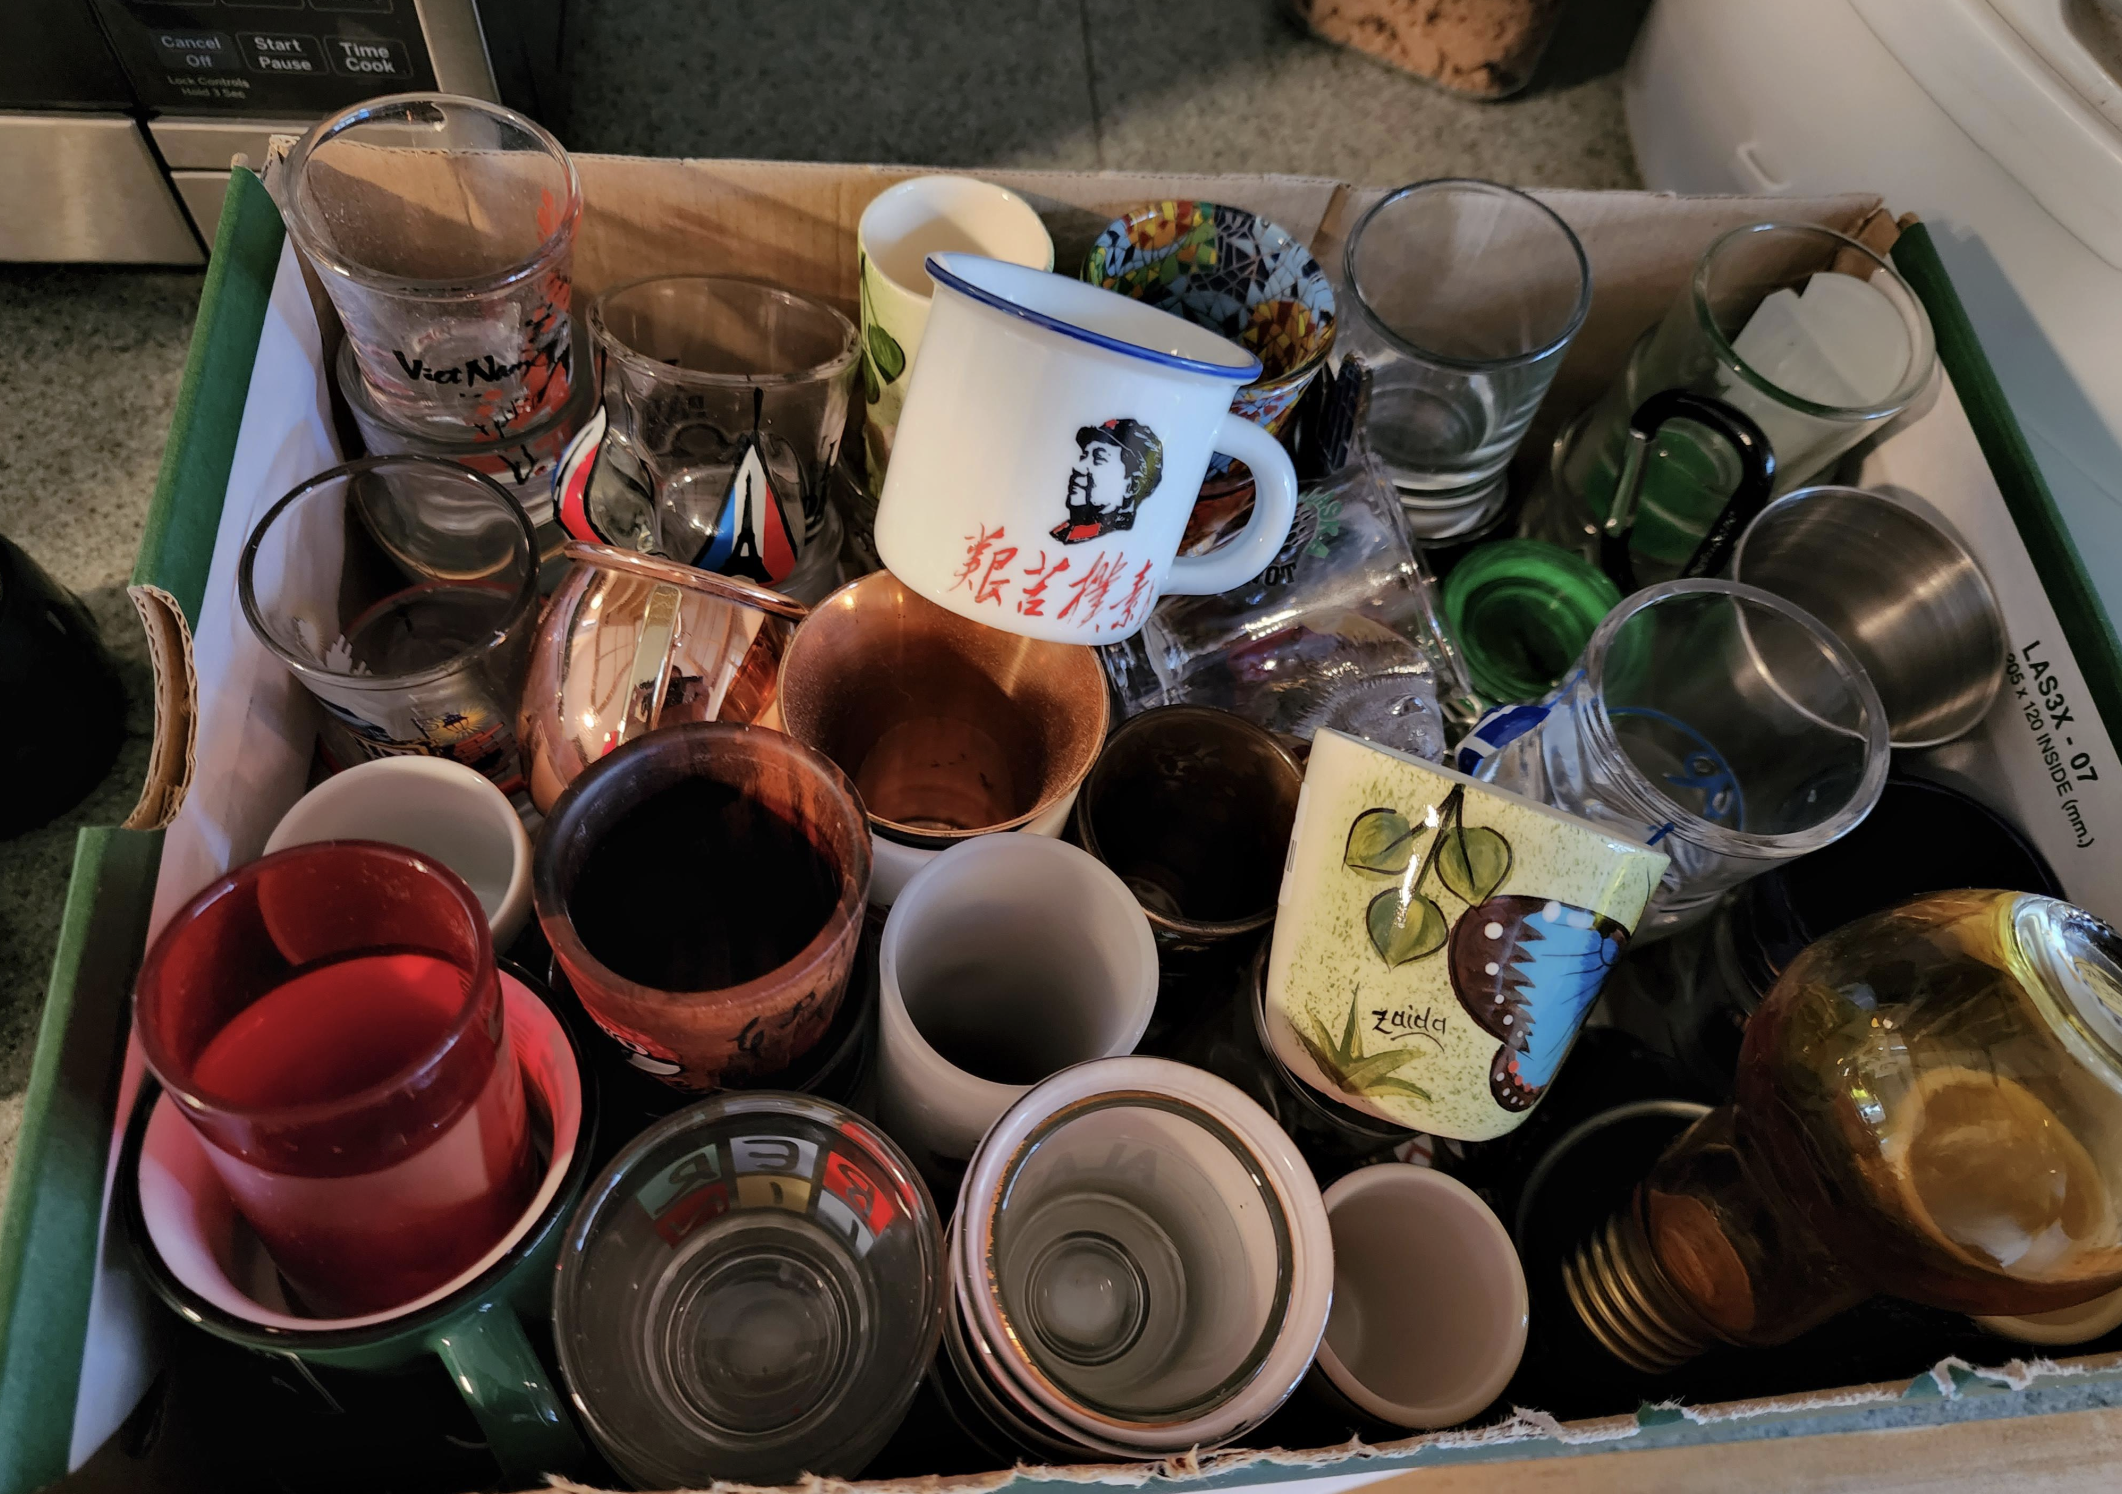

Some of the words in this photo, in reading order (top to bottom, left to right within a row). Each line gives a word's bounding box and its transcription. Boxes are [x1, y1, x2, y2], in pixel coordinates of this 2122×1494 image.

[160, 36, 222, 50] Cancel
[253, 37, 302, 53] Start
[339, 42, 389, 58] Time
[185, 54, 212, 68] Off
[258, 56, 312, 72] Pause
[345, 58, 395, 74] Cook
[197, 76, 250, 89] Controls
[2021, 640, 2074, 730] LAS3X
[2069, 752, 2099, 782] 07
[2023, 701, 2045, 732] 120
[2036, 733, 2074, 797] INSIDE
[2060, 799, 2095, 849] (mm.)
